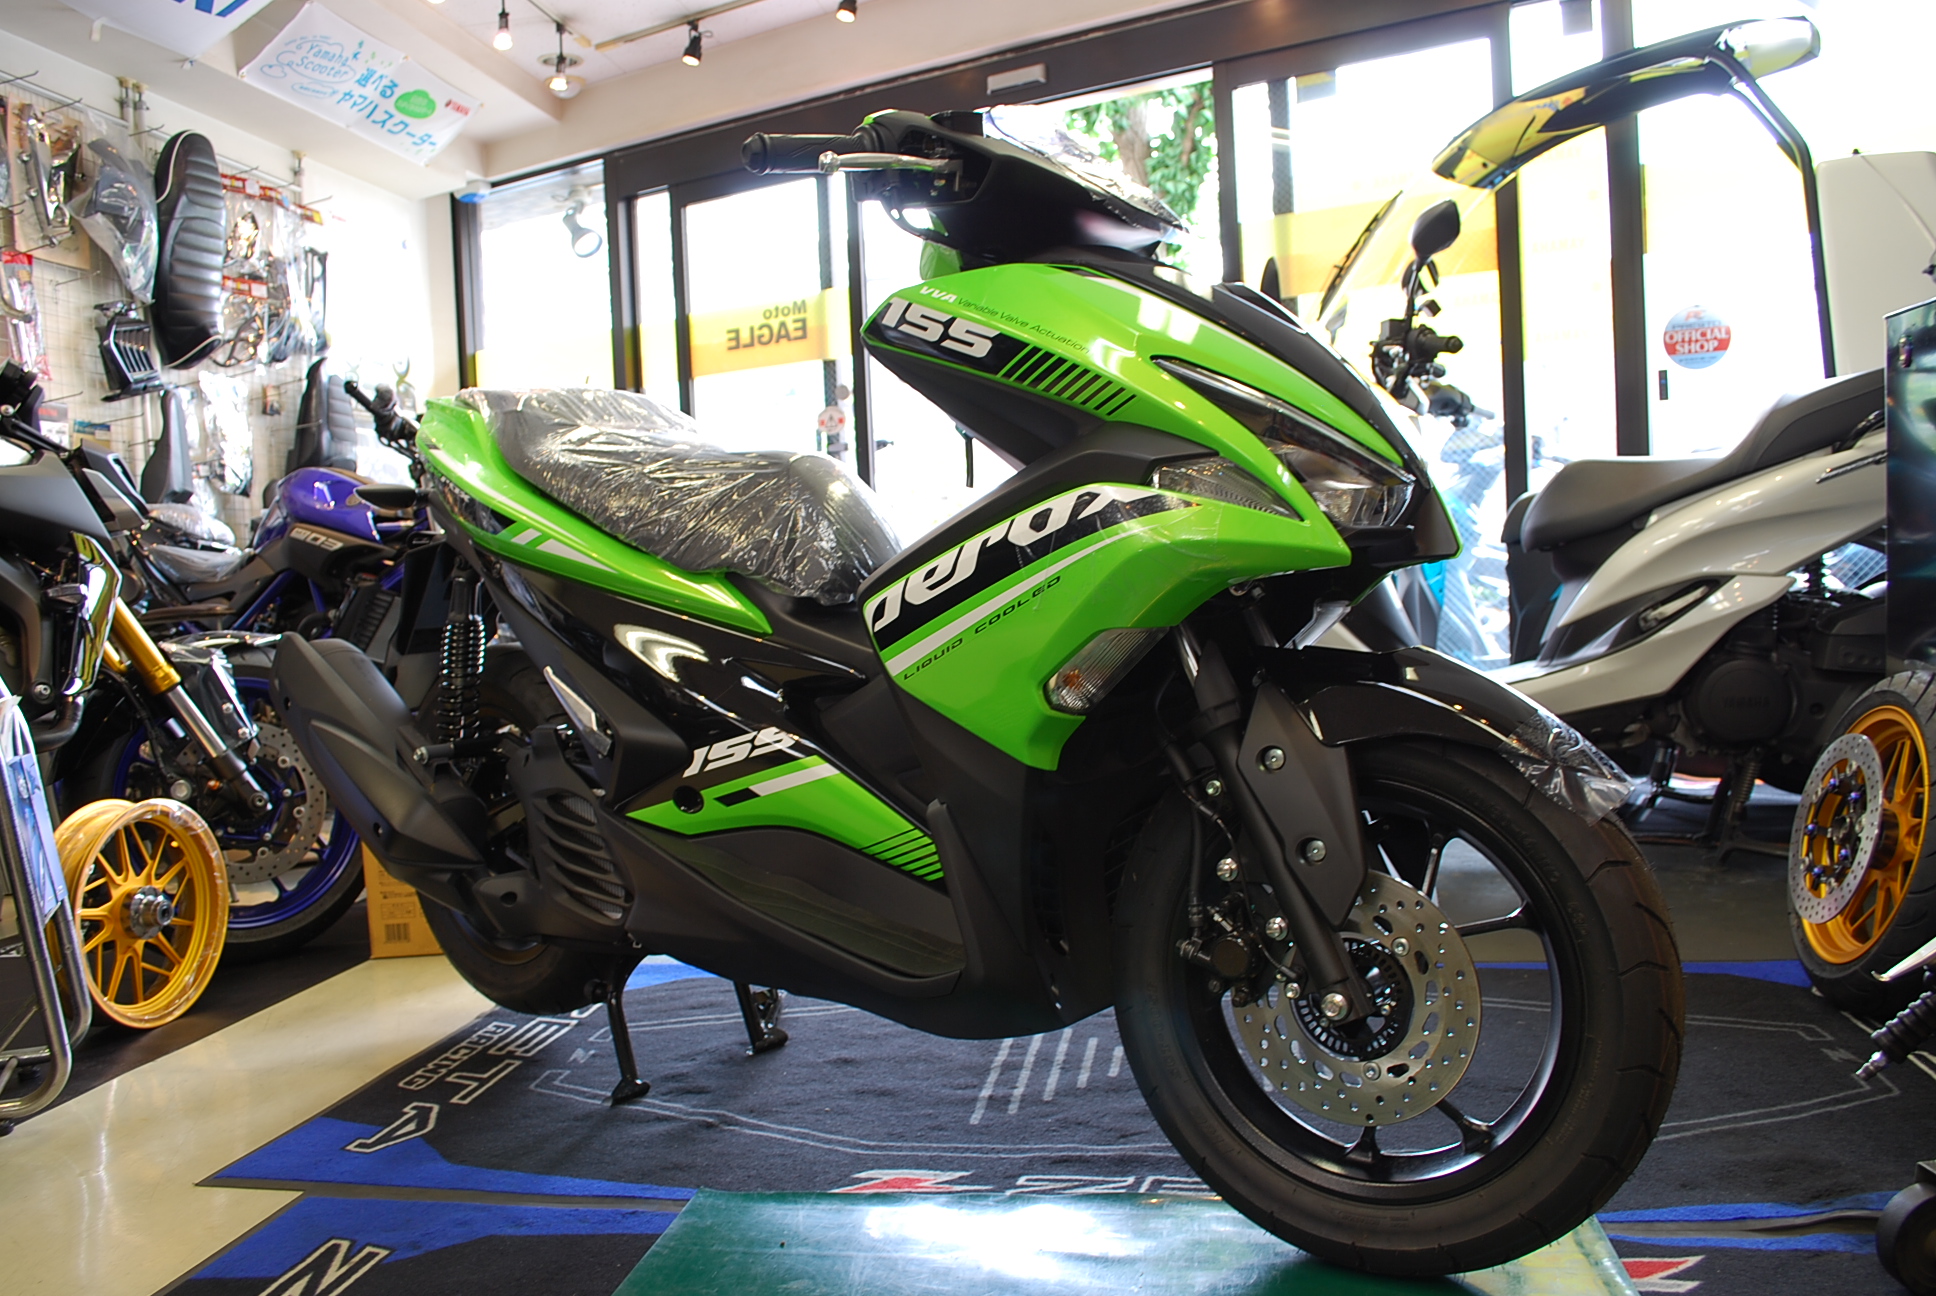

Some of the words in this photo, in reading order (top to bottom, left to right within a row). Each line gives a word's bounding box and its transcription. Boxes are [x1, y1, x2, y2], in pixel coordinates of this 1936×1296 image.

[297, 55, 350, 79] Scooter
[305, 42, 351, 67] Yamaha
[353, 66, 399, 99] 選べる
[336, 88, 437, 148] ヤマハスクーター
[881, 296, 1001, 359] 155
[919, 285, 957, 303] VVA
[957, 297, 999, 318] Variable
[1000, 311, 1029, 329] Valve
[1029, 323, 1091, 355] Actuation
[1664, 326, 1731, 344] OFFICIAL
[1674, 339, 1720, 355] SHOP
[903, 637, 964, 681] LIQUID
[973, 574, 1062, 635] COOLED
[682, 725, 797, 779] 155
[398, 1020, 517, 1090] RACING
